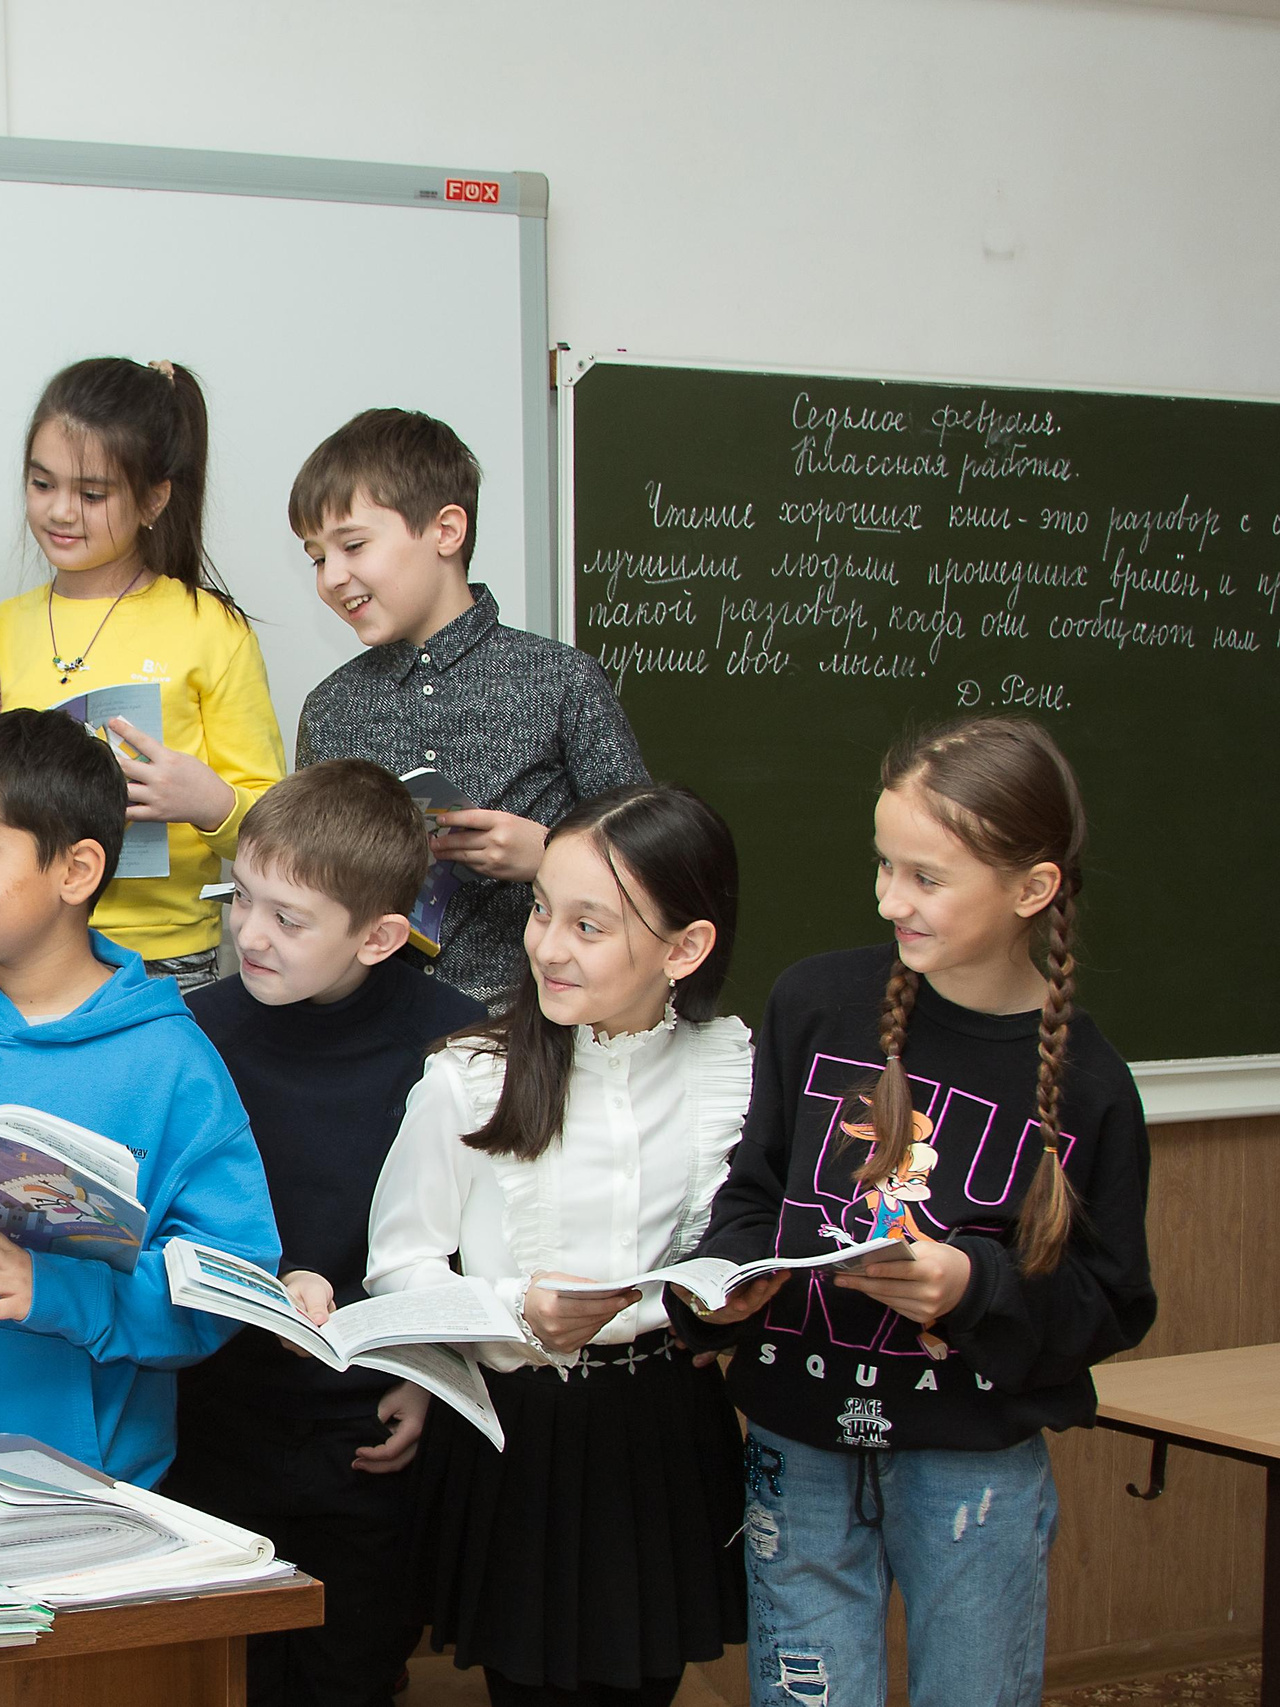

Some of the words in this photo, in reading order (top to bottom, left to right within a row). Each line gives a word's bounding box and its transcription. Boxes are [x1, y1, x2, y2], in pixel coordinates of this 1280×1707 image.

[446, 179, 499, 203] FOX
[792, 392, 908, 457] Седьмое
[931, 400, 1062, 449] февраля.
[791, 436, 949, 477] Классная
[958, 444, 1080, 494] работа.
[645, 480, 756, 529] Чтение
[778, 498, 922, 543] хороших
[1039, 508, 1089, 535] это
[1102, 494, 1221, 562] разговор
[1240, 514, 1252, 533] с
[583, 549, 743, 603] лучшими
[771, 553, 900, 605] людьми
[928, 558, 1089, 613] прошедших
[1110, 548, 1209, 611] времён,
[1220, 573, 1238, 596] и
[588, 588, 698, 627] такой
[715, 584, 879, 650] разговор,
[889, 604, 967, 665] когда
[981, 610, 1030, 639] они
[1048, 597, 1196, 651] сообщают
[1213, 626, 1262, 652] нам
[596, 641, 710, 698] лучшие
[819, 653, 927, 679] мысли.
[126, 1144, 148, 1159] way
[843, 1420, 882, 1443] JAM
[844, 1397, 883, 1417] SPACE
